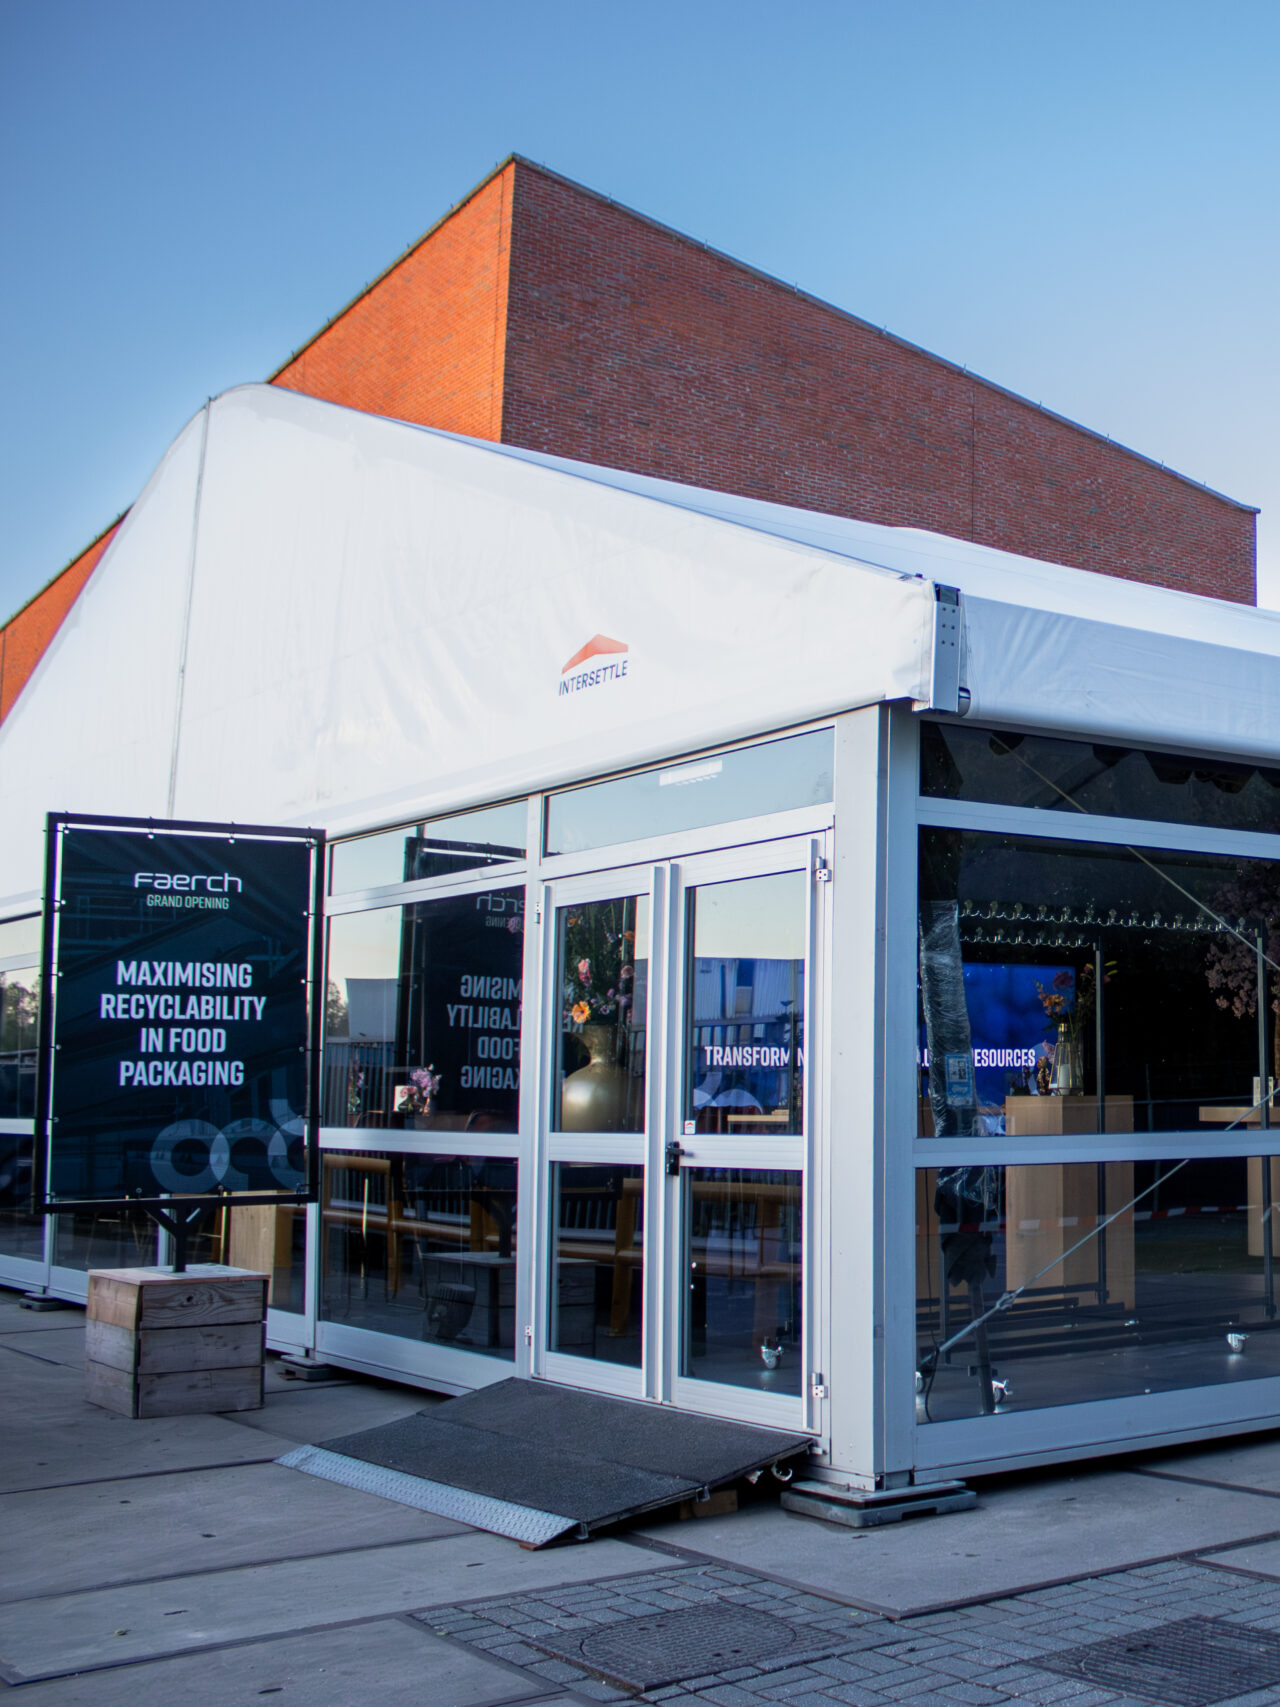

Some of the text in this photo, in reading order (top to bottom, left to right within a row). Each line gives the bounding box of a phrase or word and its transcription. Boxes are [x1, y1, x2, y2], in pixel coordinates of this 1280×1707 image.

[558, 659, 628, 697] INTERSETTLE
[146, 894, 230, 910] GRAND OPENING
[116, 960, 253, 988] MAXIMISING
[99, 993, 267, 1021] RECYCLABILITY
[139, 1027, 227, 1053] IN FOOD
[972, 1048, 1036, 1067] ESOURCES
[119, 1060, 245, 1086] PACKAGING
